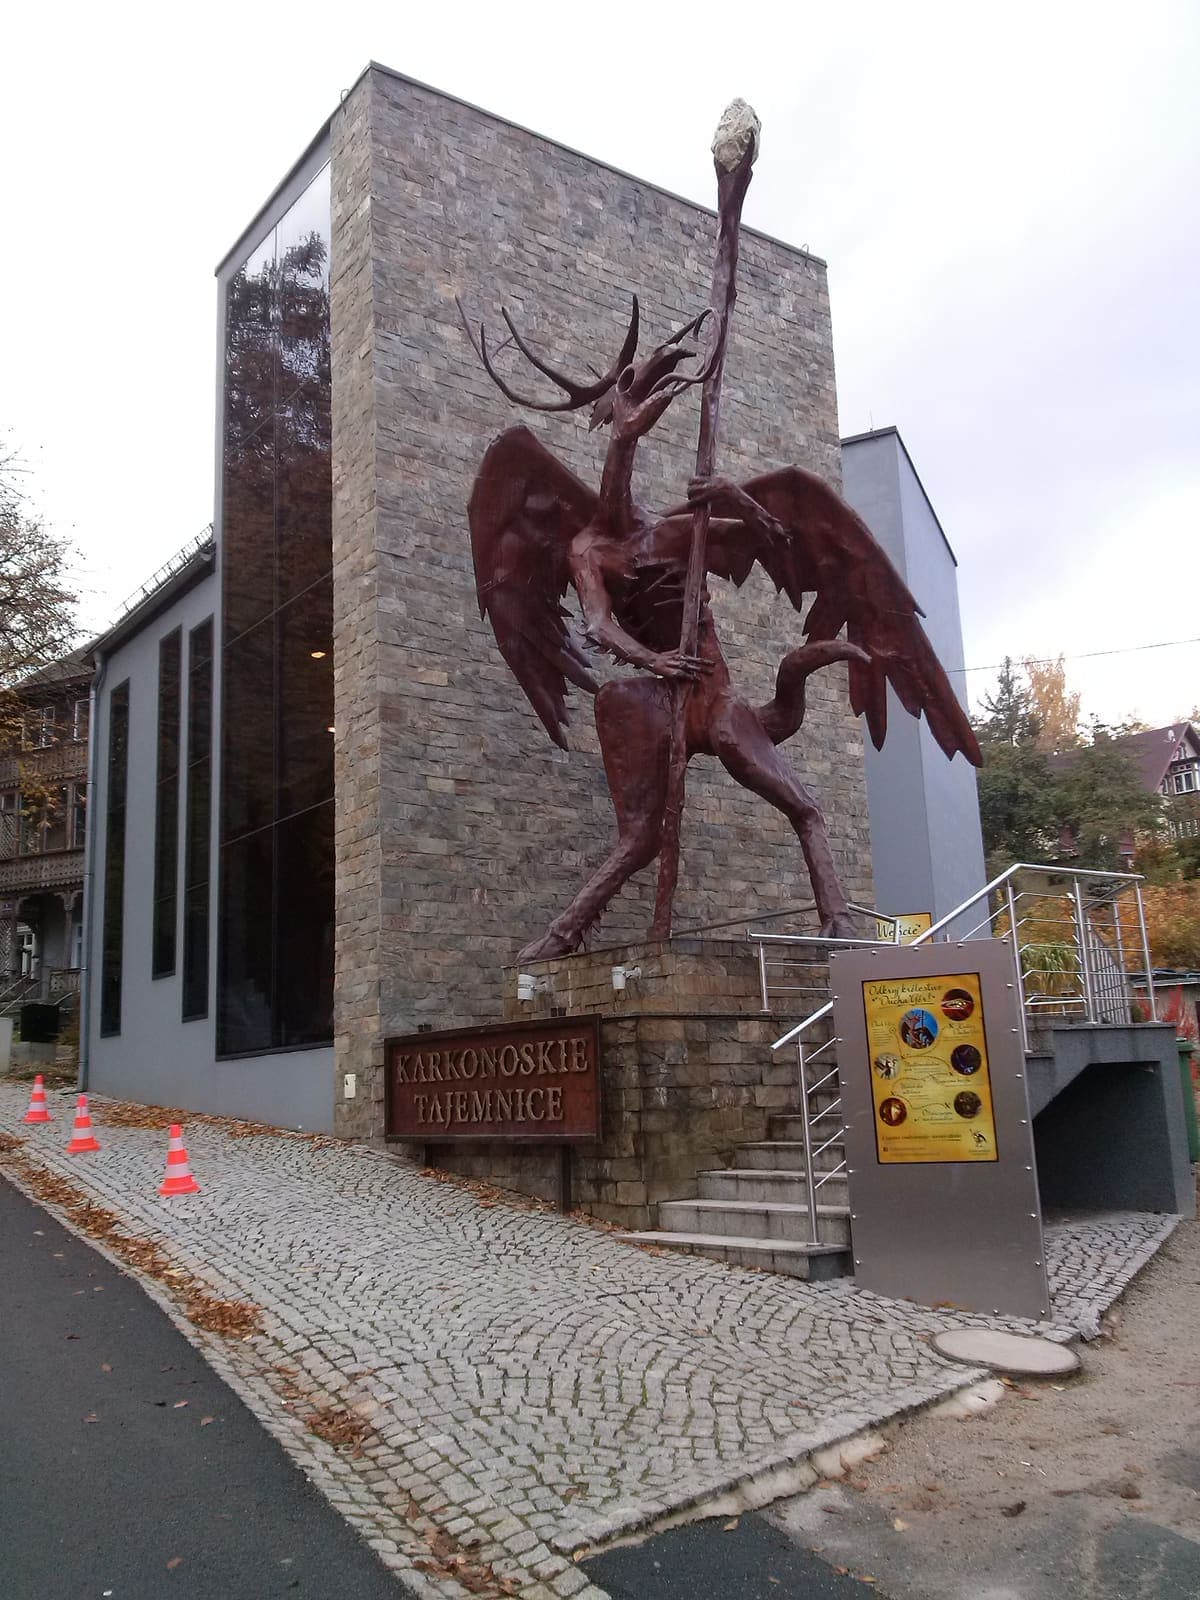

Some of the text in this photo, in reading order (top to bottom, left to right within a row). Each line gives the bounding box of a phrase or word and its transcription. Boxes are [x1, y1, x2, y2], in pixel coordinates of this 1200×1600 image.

[868, 985, 899, 997] Odkryj
[397, 1037, 589, 1084] KARKONOSKIE
[413, 1086, 566, 1129] TAJEMNICE
